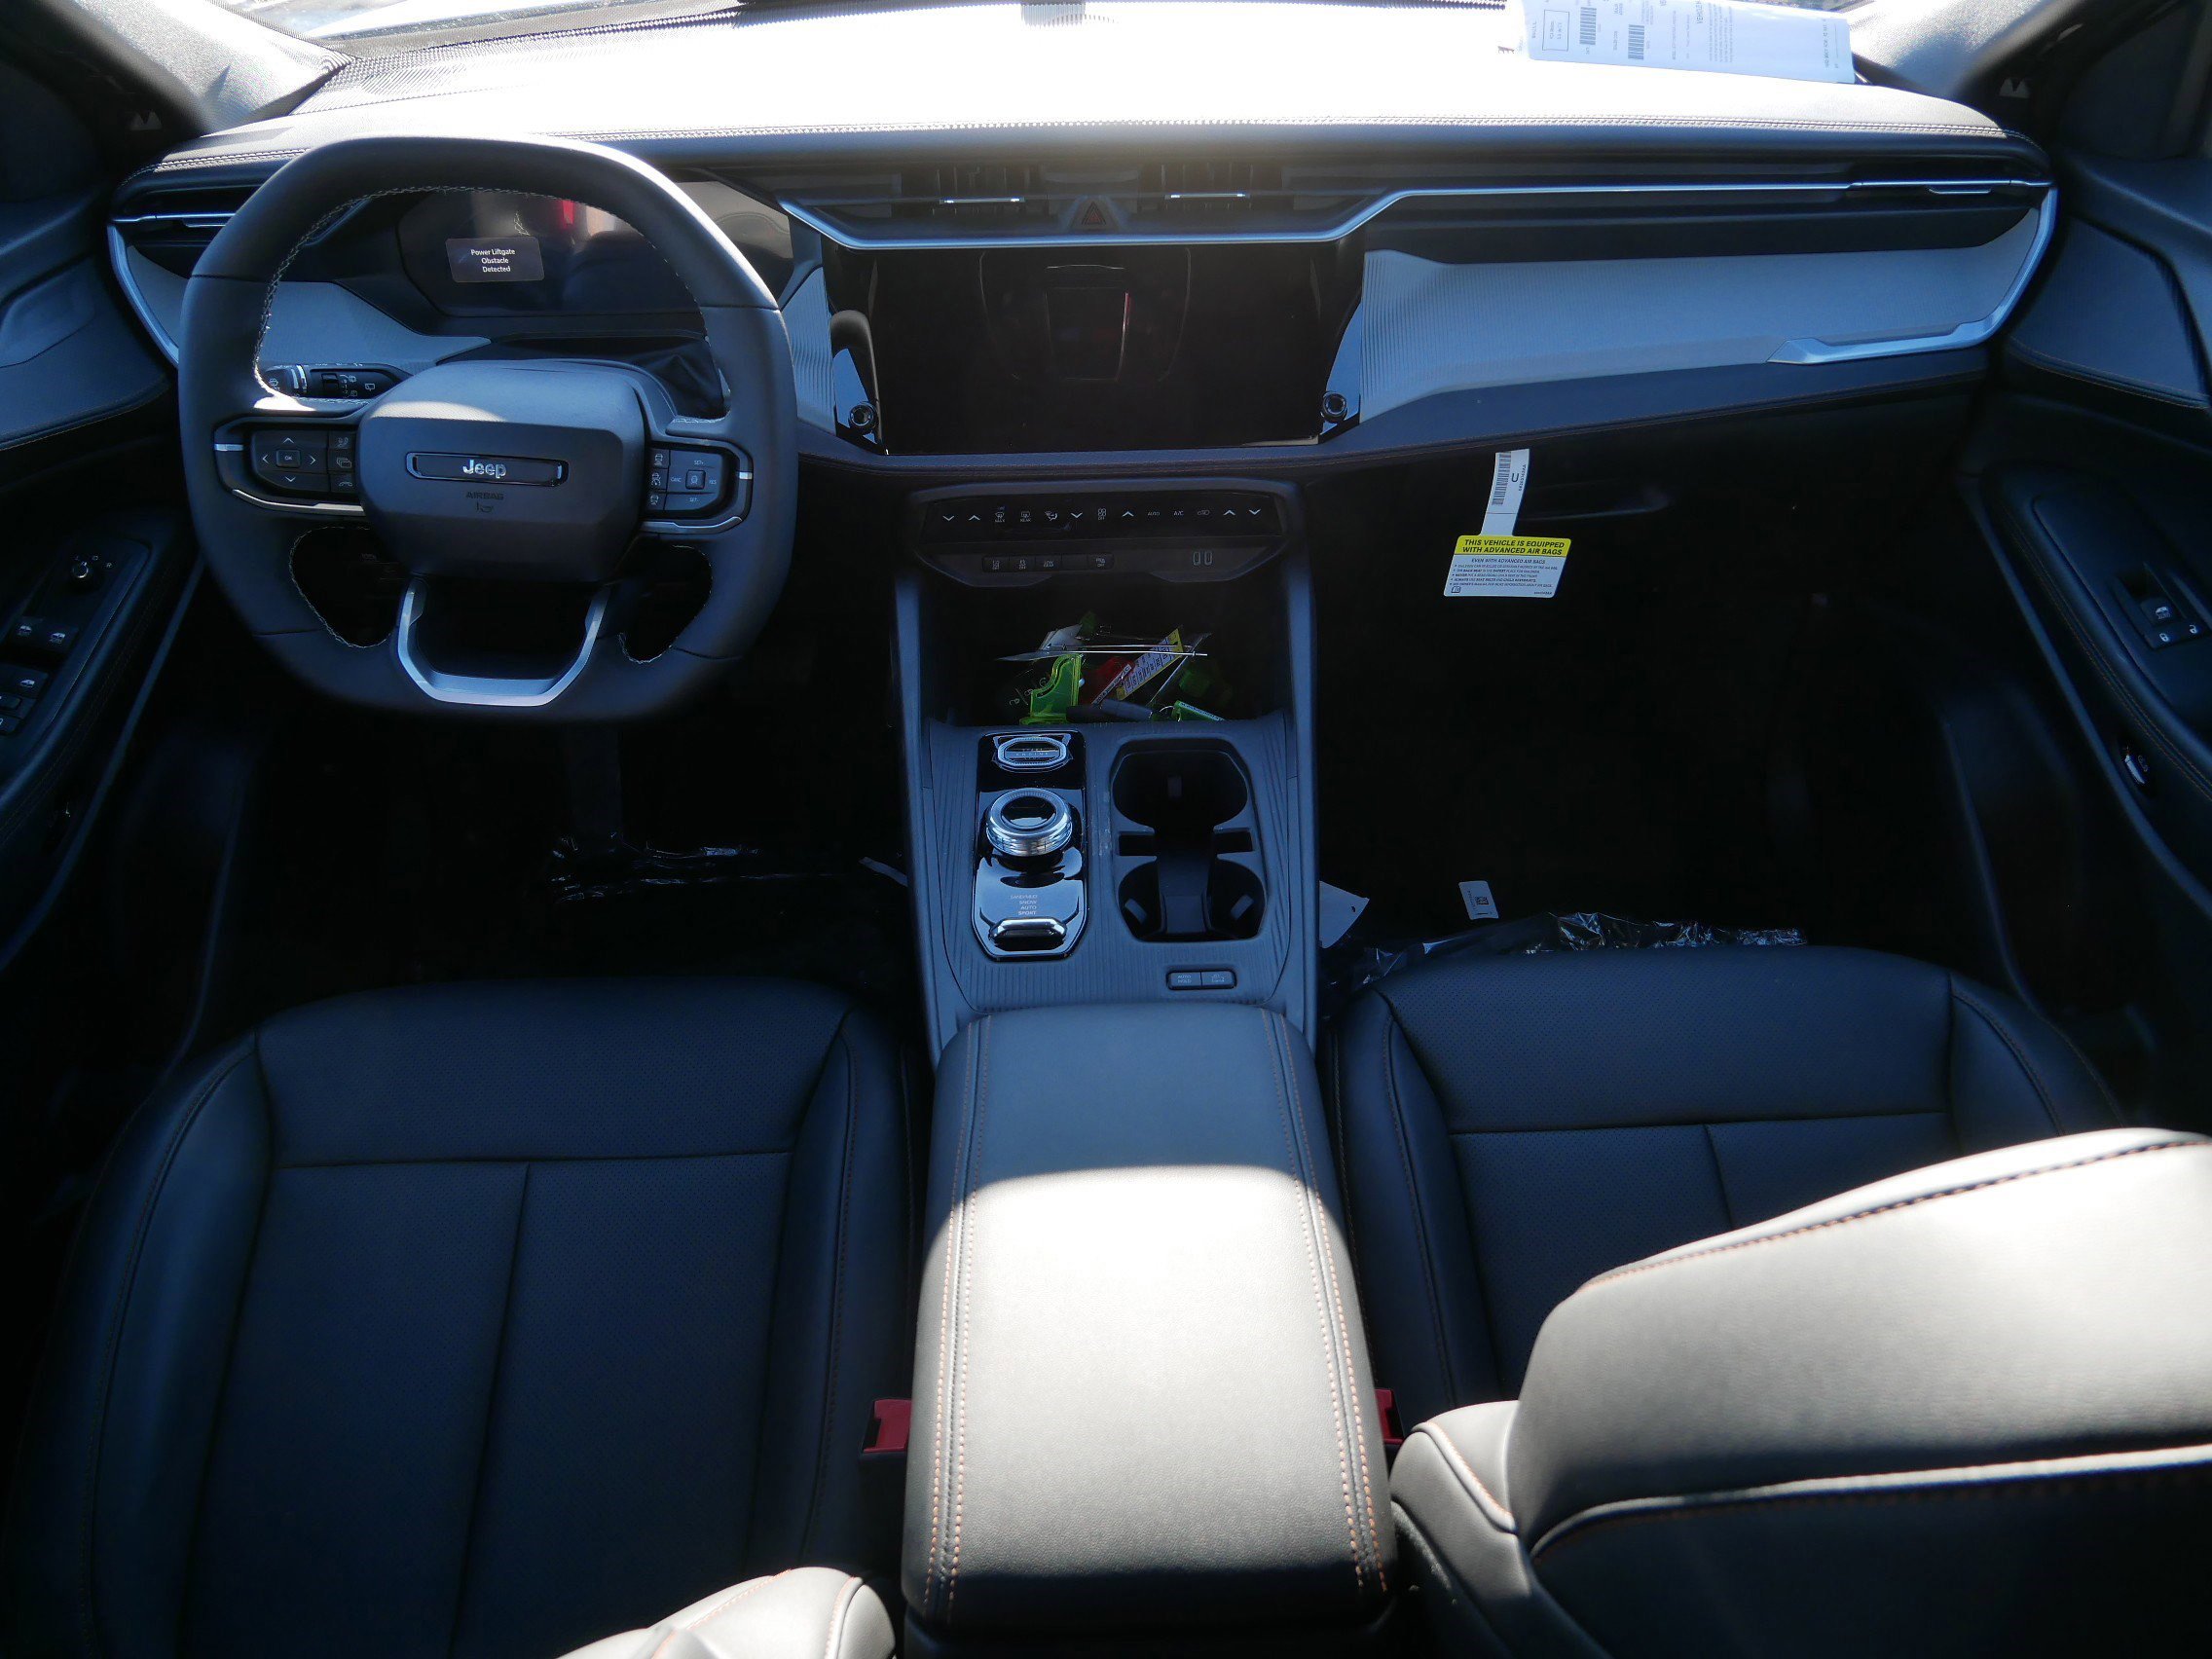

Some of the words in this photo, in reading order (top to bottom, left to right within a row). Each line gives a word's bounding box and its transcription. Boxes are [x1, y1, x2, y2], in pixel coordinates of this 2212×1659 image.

[462, 459, 507, 479] Jeep
[1511, 473, 1519, 483] U
[465, 491, 504, 500] AIRBAG
